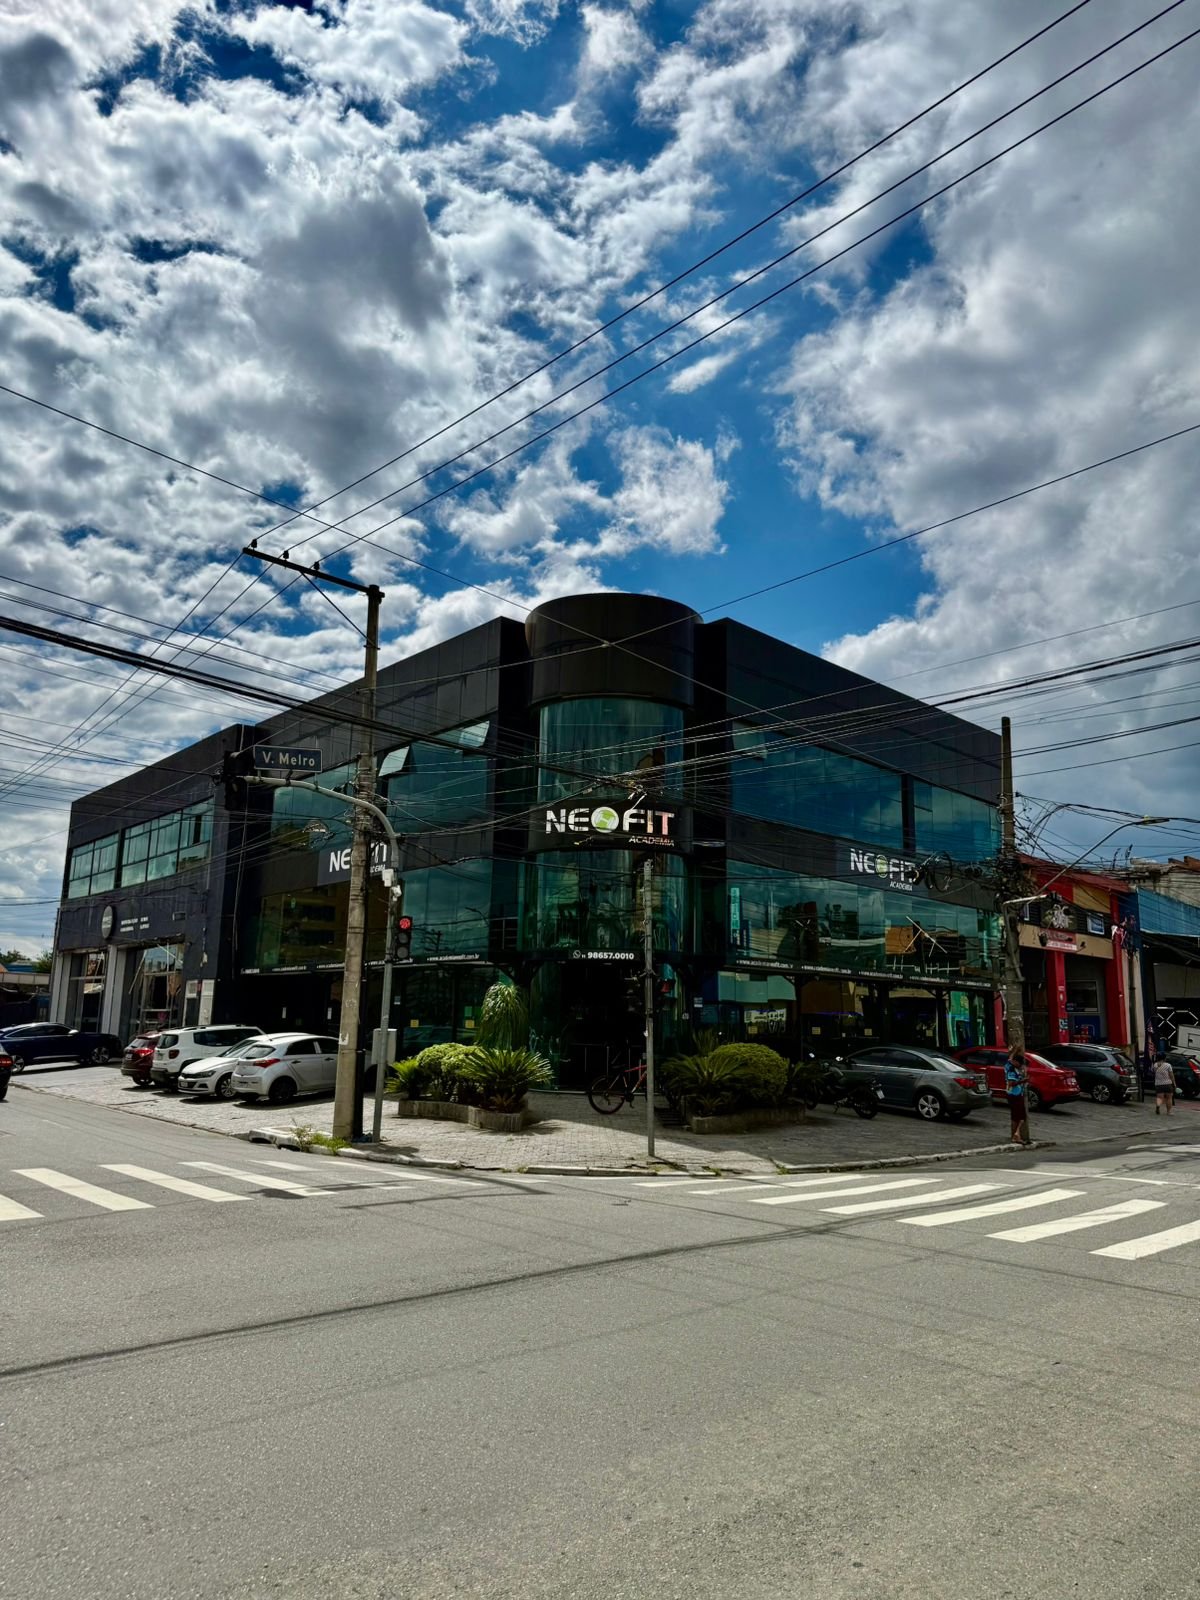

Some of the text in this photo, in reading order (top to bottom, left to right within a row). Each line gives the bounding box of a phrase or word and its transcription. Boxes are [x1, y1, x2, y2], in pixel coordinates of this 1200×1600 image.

[262, 751, 315, 767] V. Melro
[545, 807, 675, 835] NEOFIT
[628, 835, 675, 847] ACADEMIA
[587, 951, 635, 960] 98657.0010
